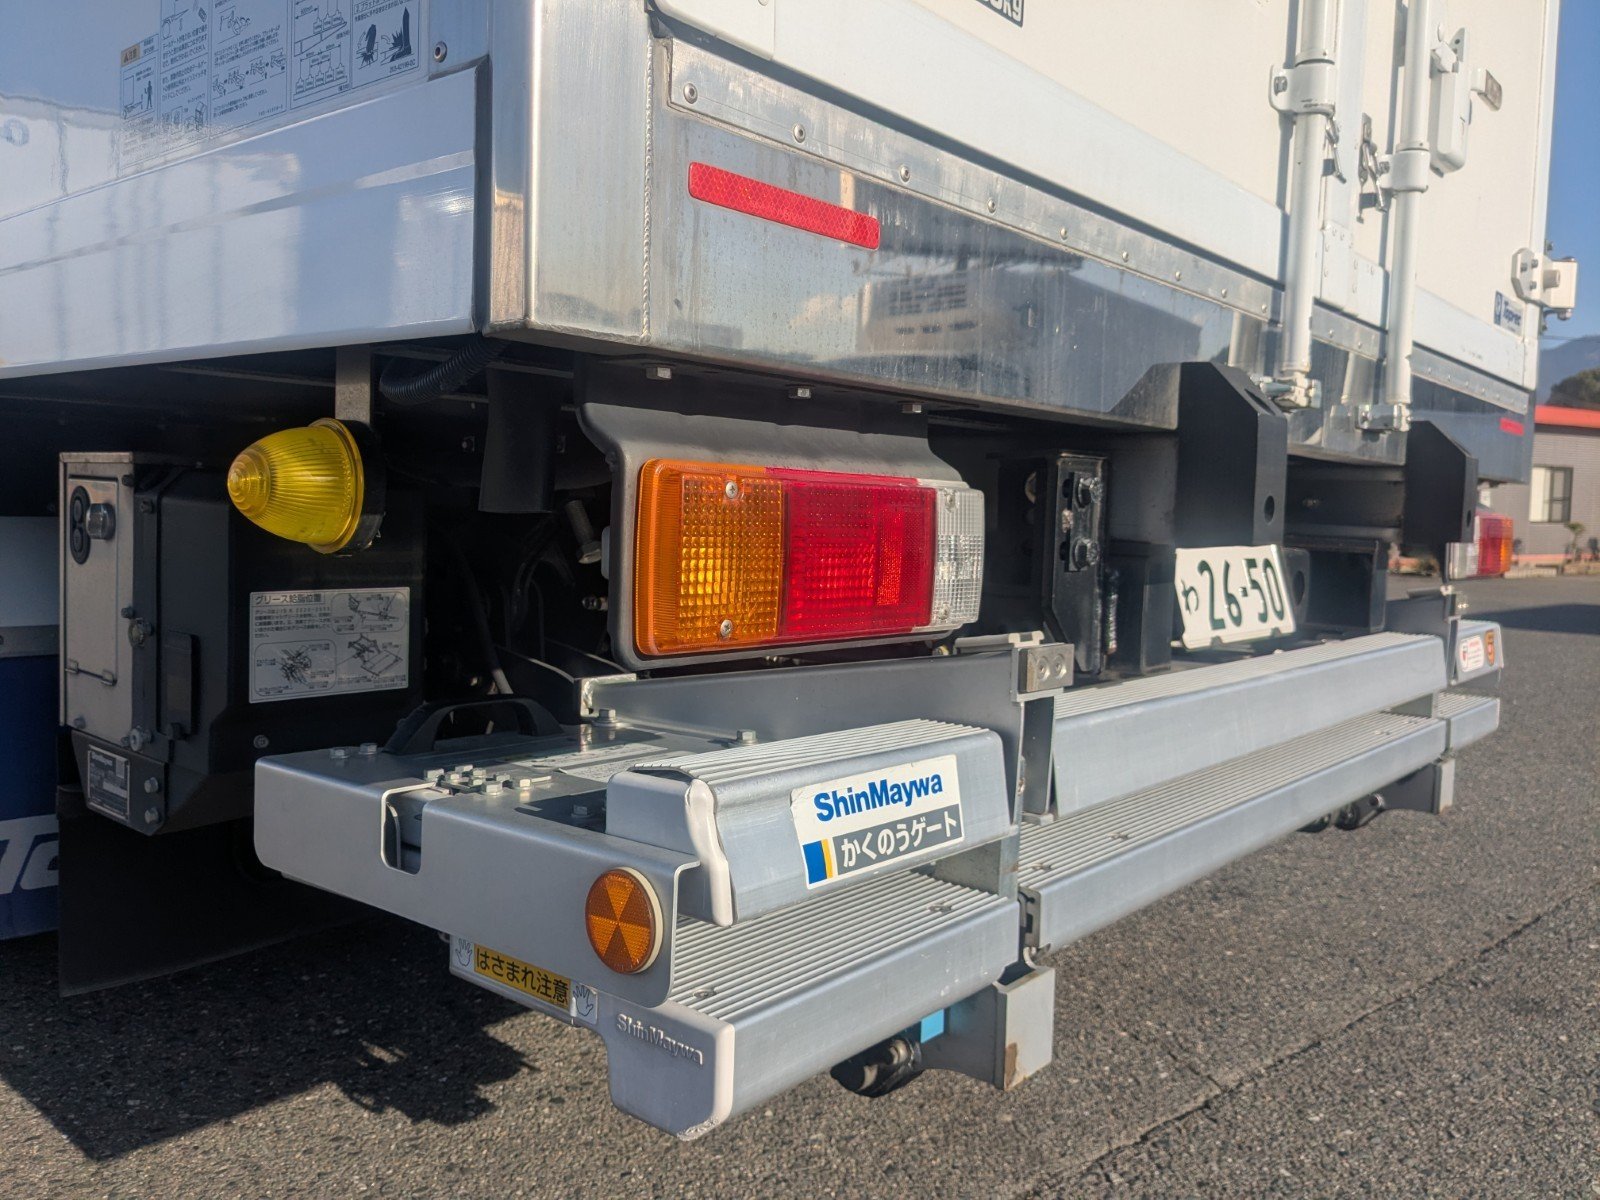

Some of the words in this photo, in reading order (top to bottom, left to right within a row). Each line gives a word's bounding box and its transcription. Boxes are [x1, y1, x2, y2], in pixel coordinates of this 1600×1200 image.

[1197, 558, 1285, 630] 26-50
[813, 773, 943, 822] ShinMaywa
[841, 811, 957, 867] かくのうゲート
[476, 947, 570, 1006] はさまれ注意
[616, 1013, 704, 1066] ShinMaywa
